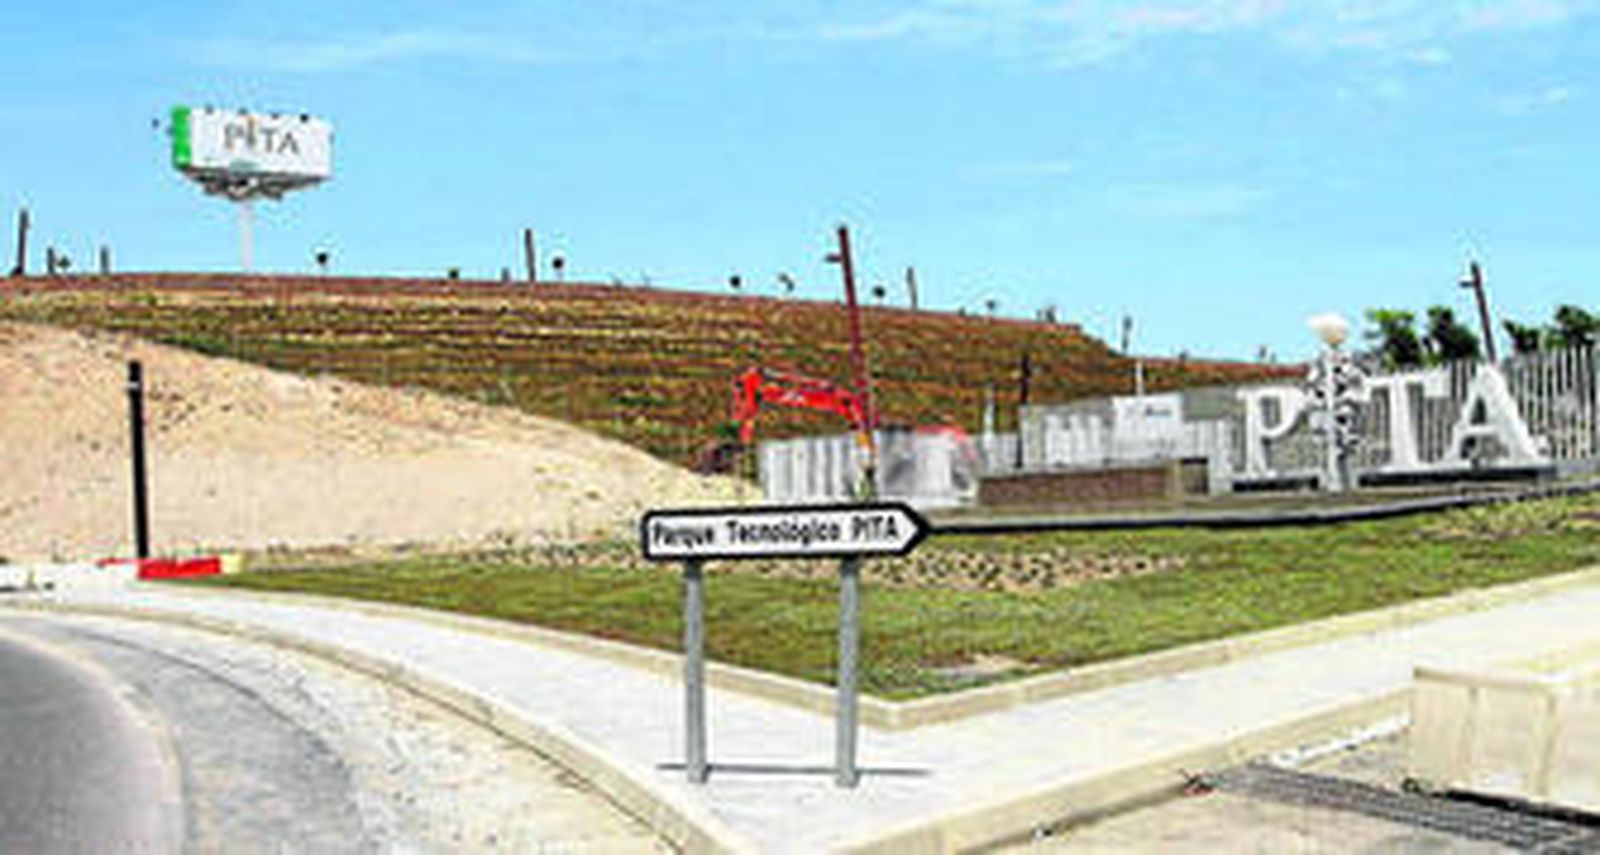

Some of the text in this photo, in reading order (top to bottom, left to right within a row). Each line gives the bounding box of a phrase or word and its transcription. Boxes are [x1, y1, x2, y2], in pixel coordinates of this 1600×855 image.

[223, 116, 300, 154] PITA
[653, 521, 714, 549] Parque
[851, 514, 899, 541] PITA
